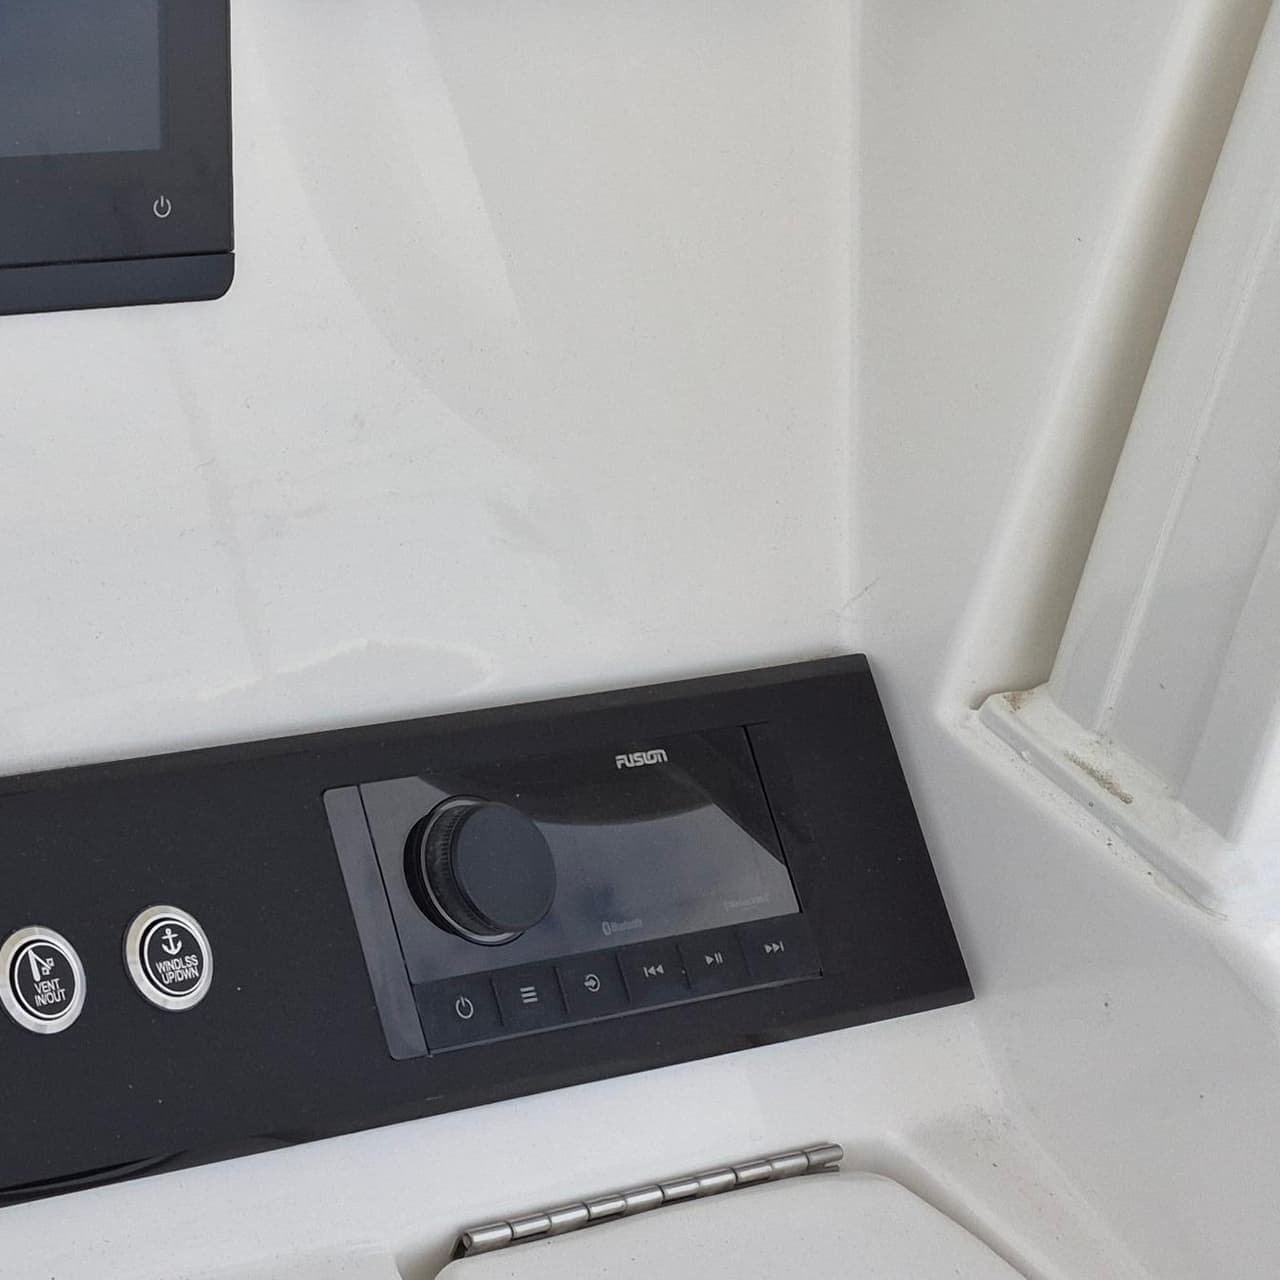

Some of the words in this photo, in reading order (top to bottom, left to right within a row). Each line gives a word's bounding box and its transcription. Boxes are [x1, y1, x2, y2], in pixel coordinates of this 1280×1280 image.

[616, 748, 668, 769] FUSION
[156, 955, 198, 975] WINDLSS
[161, 968, 199, 984] UP/DWN
[34, 978, 60, 994] VENT
[34, 989, 66, 1006] IN/OUT
